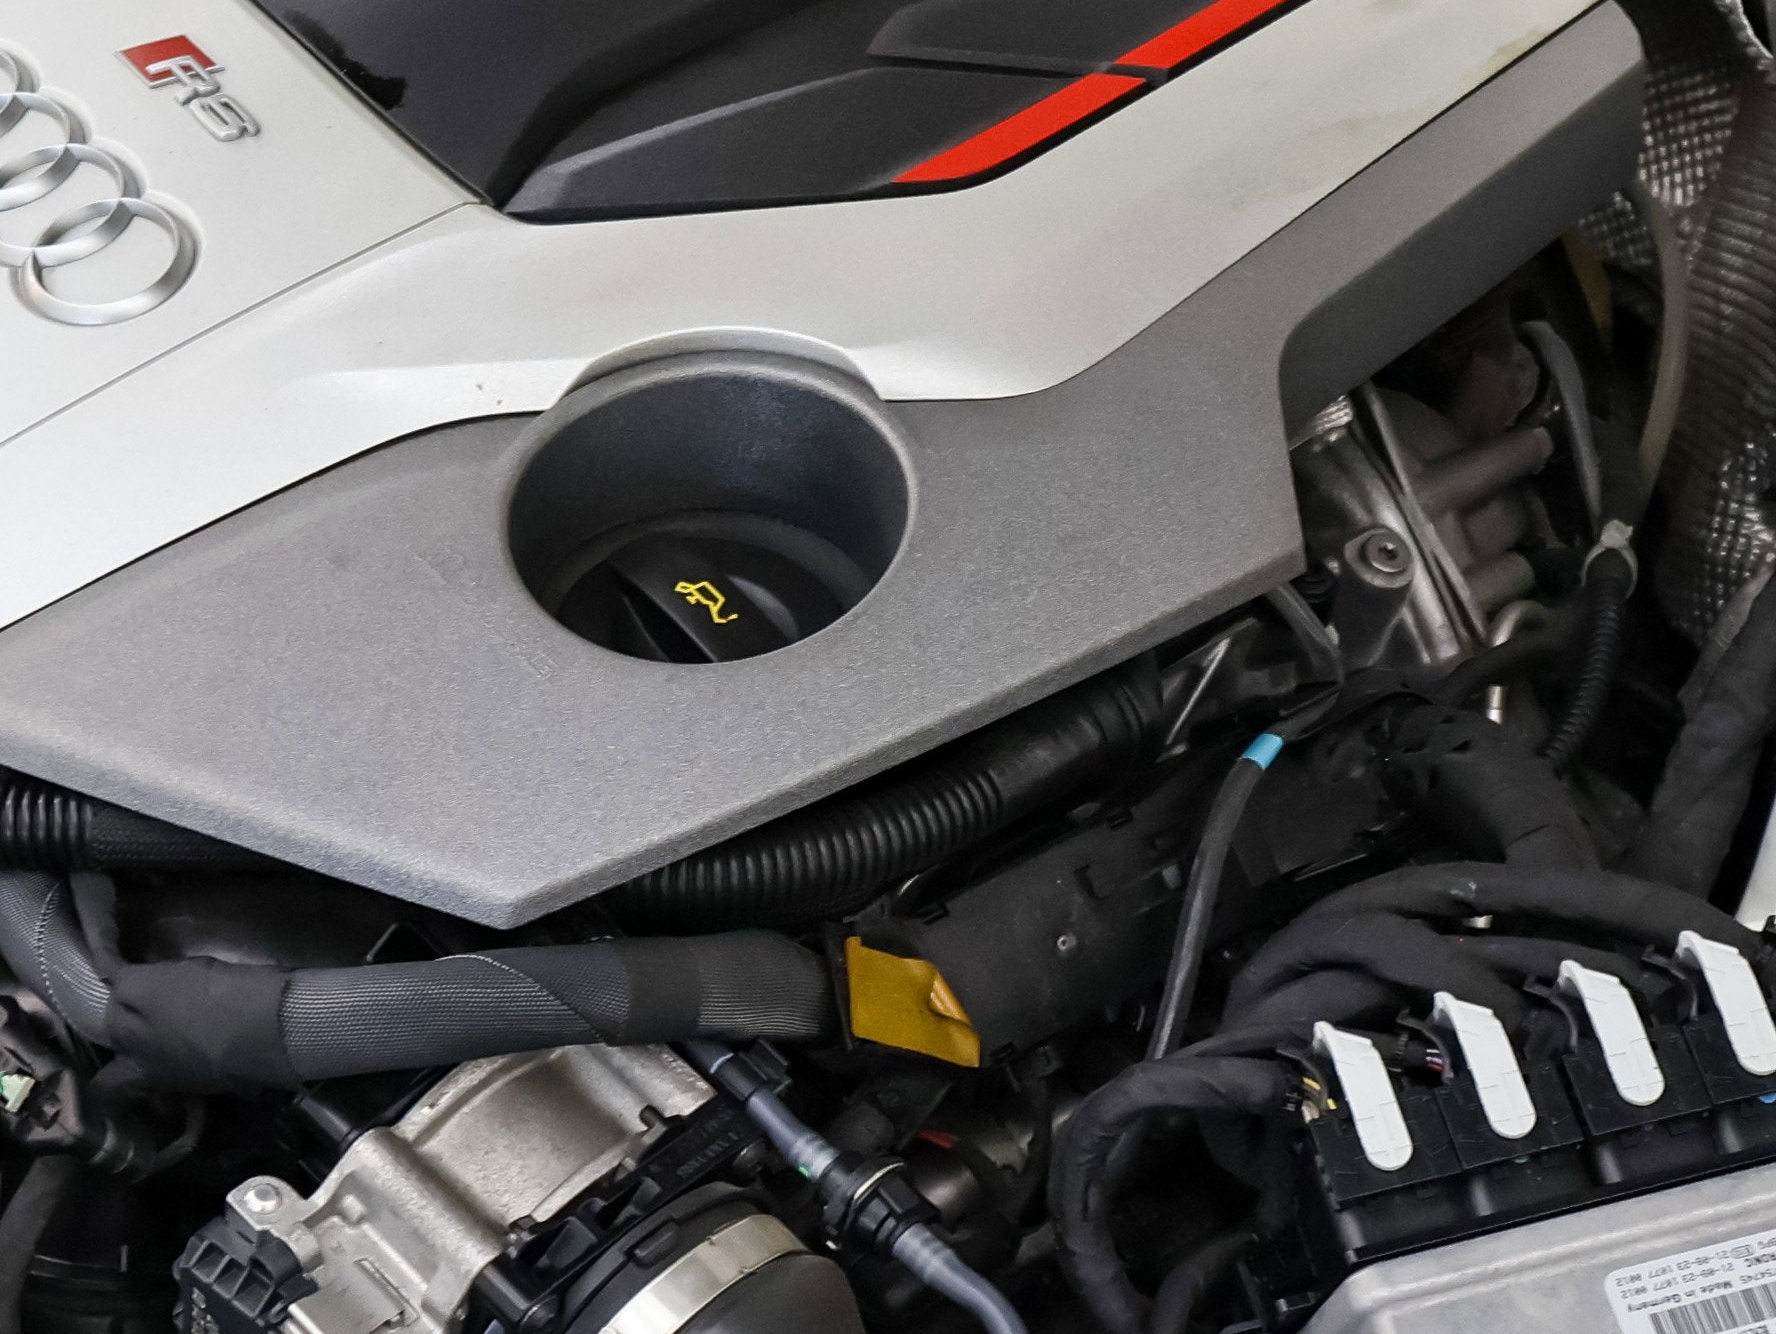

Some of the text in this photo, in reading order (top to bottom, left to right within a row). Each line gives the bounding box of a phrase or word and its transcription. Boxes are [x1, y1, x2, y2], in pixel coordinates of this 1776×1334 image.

[144, 52, 261, 142] RS
[1698, 1279, 1733, 1295] Made
[1624, 1290, 1681, 1313] Germany
